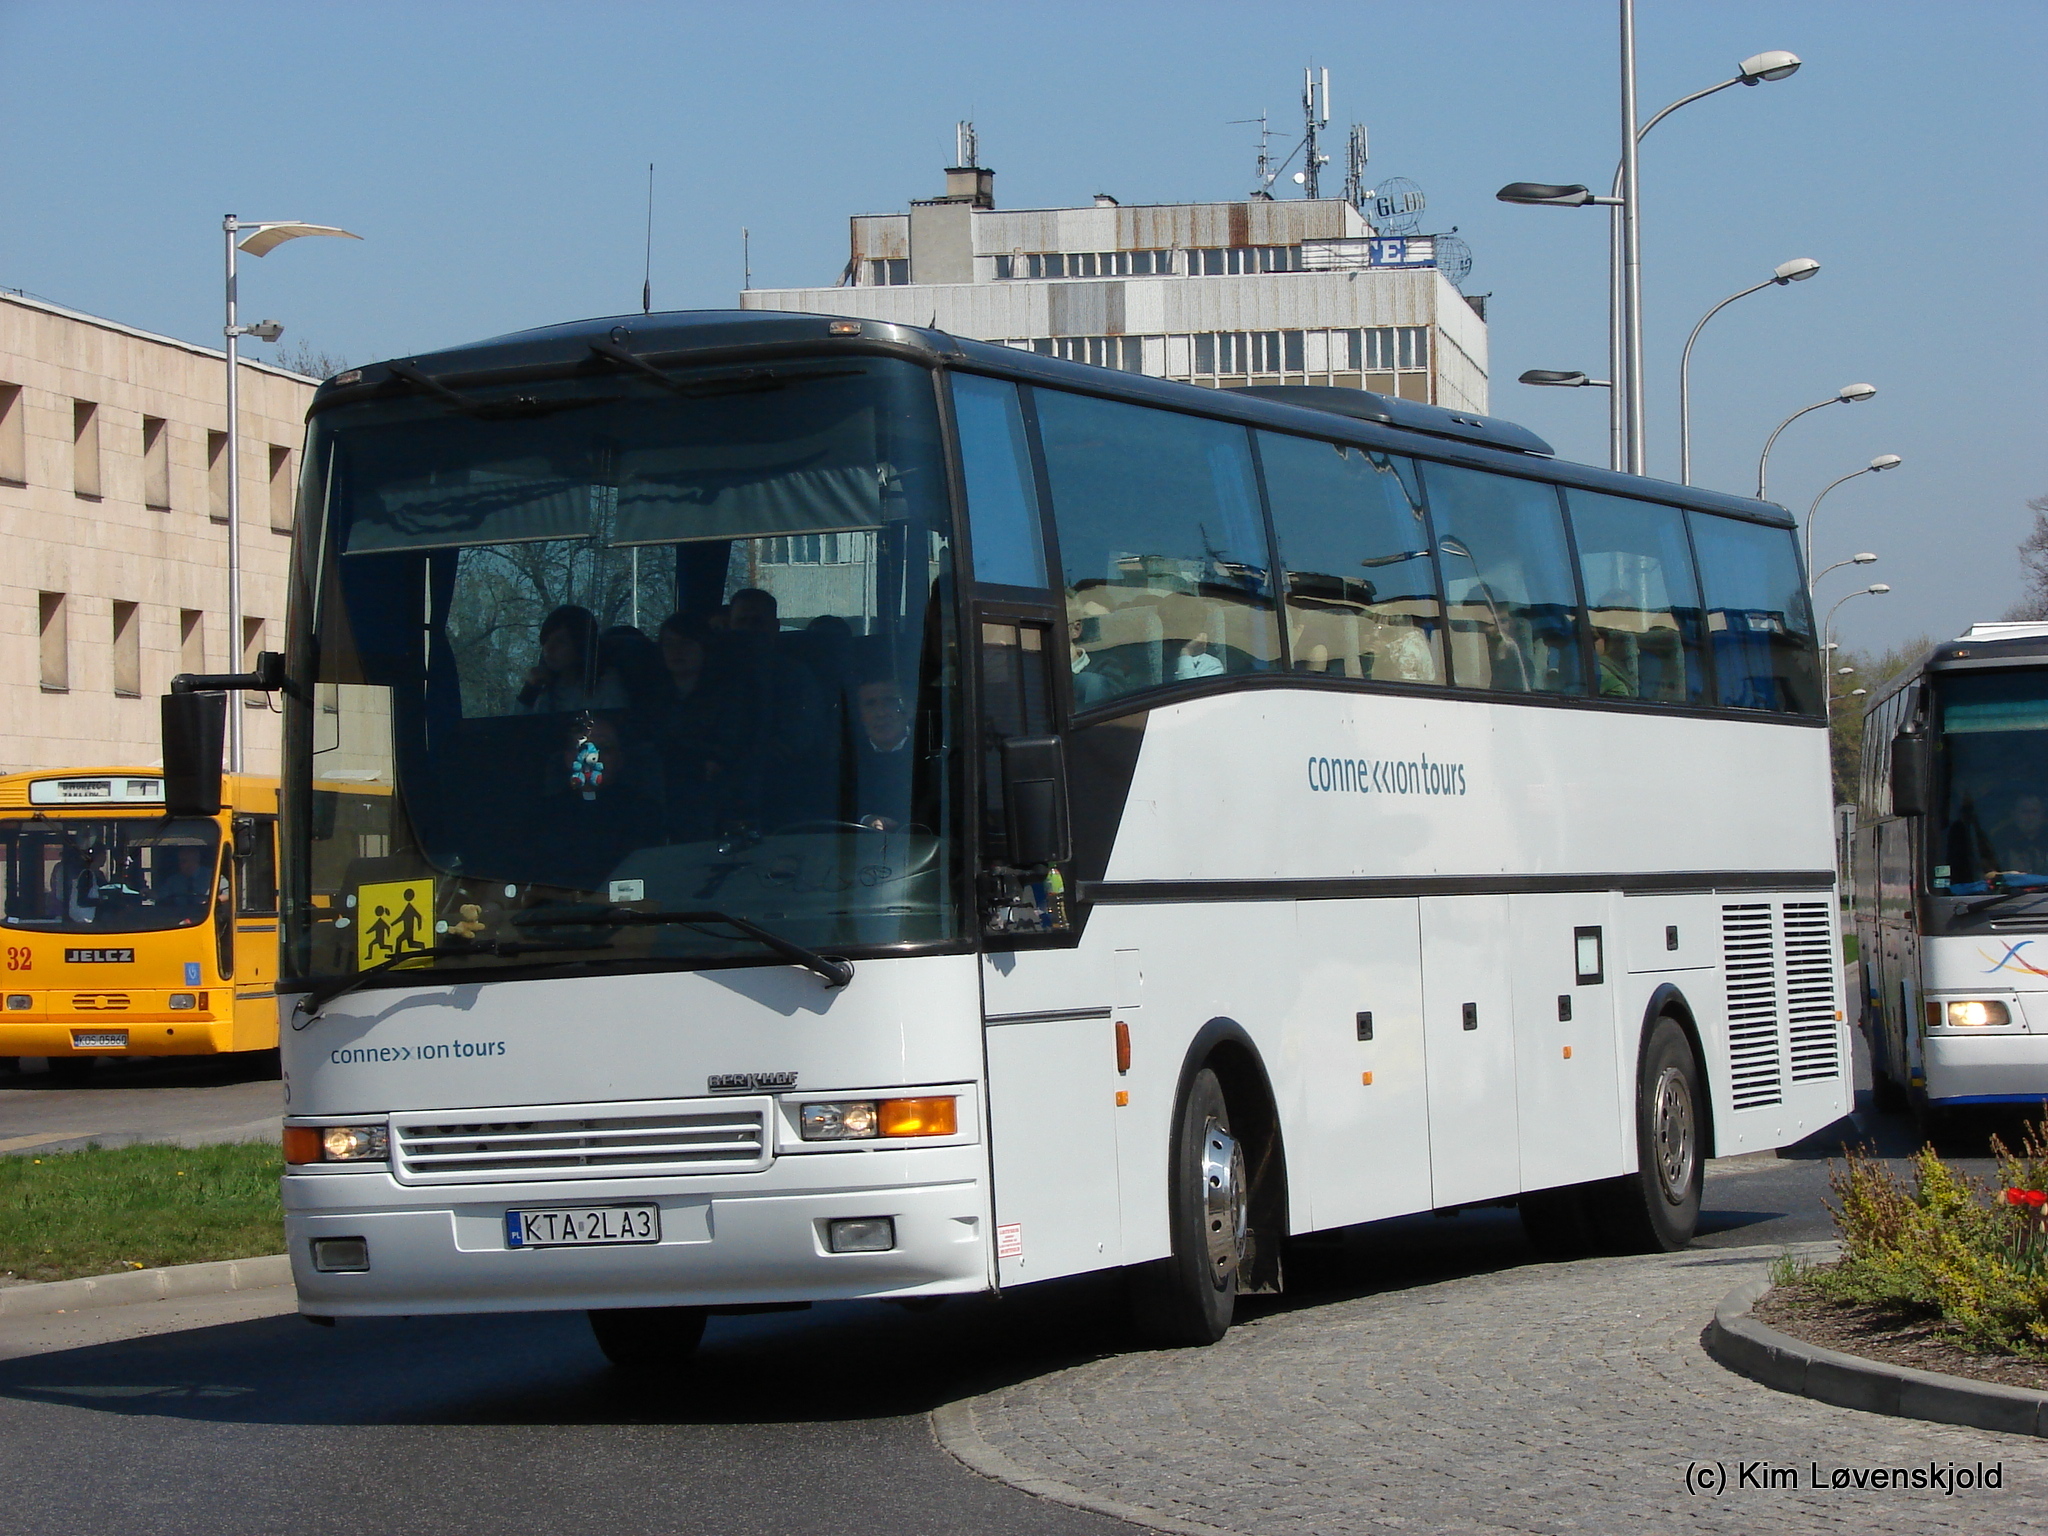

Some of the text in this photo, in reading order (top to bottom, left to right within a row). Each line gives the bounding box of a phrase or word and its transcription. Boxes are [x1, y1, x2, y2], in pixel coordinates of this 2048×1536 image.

[7, 947, 32, 970] 32
[68, 950, 132, 962] JELCZ
[708, 1071, 798, 1090] BERKHOF
[511, 1231, 522, 1240] PL
[524, 1211, 651, 1241] KTA 2LA3
